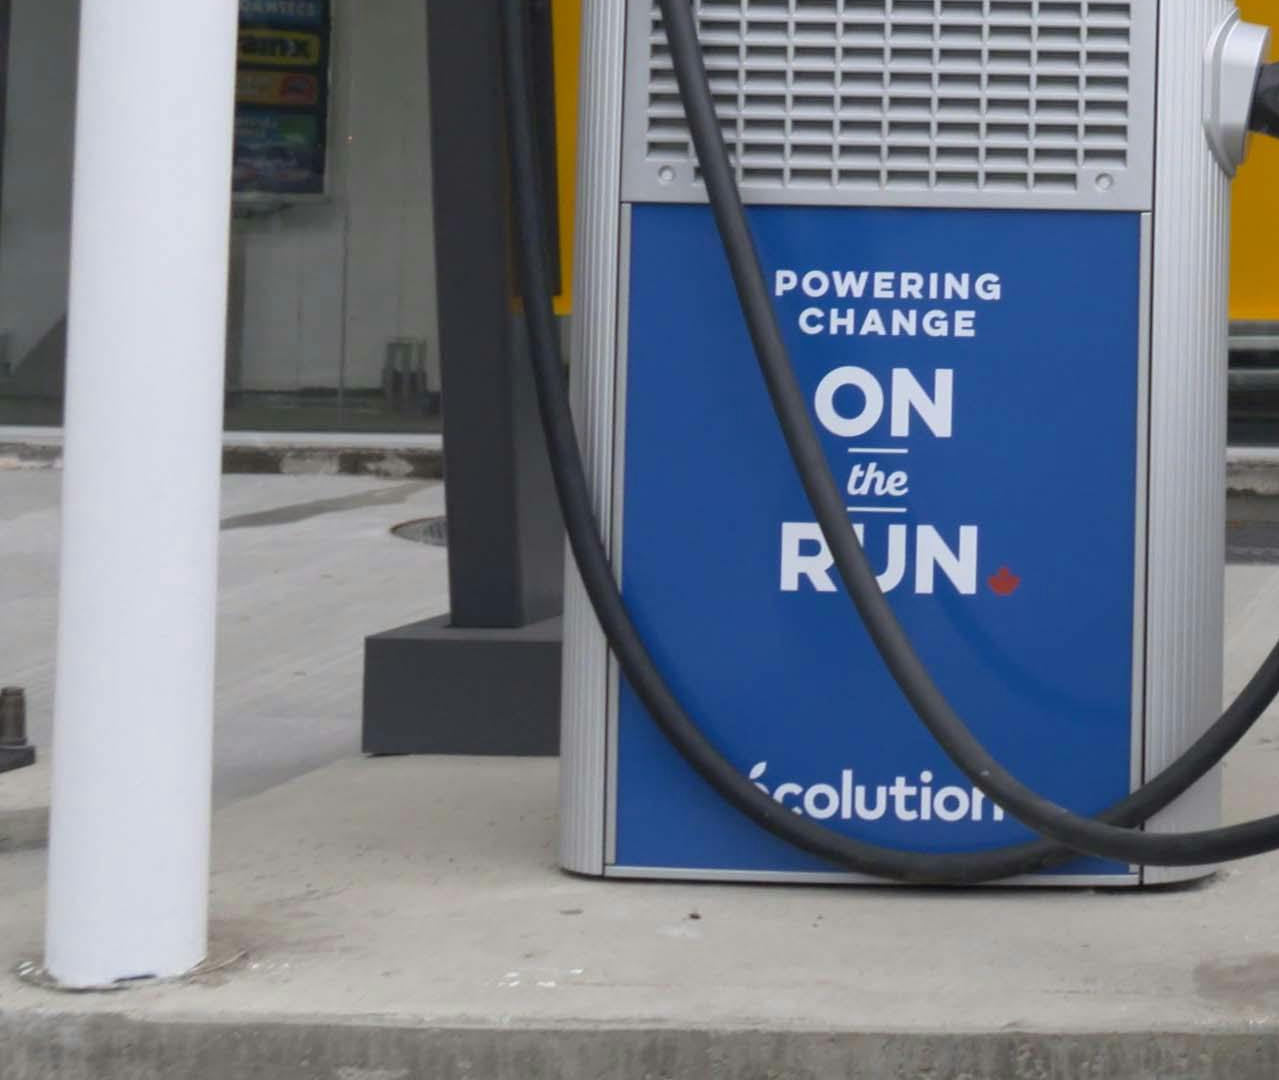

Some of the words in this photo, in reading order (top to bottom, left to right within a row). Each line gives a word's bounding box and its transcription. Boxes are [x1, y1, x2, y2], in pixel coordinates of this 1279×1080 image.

[774, 269, 1002, 300] POWERING
[798, 307, 977, 338] CHANGE
[814, 365, 954, 438] ON
[847, 462, 909, 496] the
[748, 760, 1005, 821] colution
